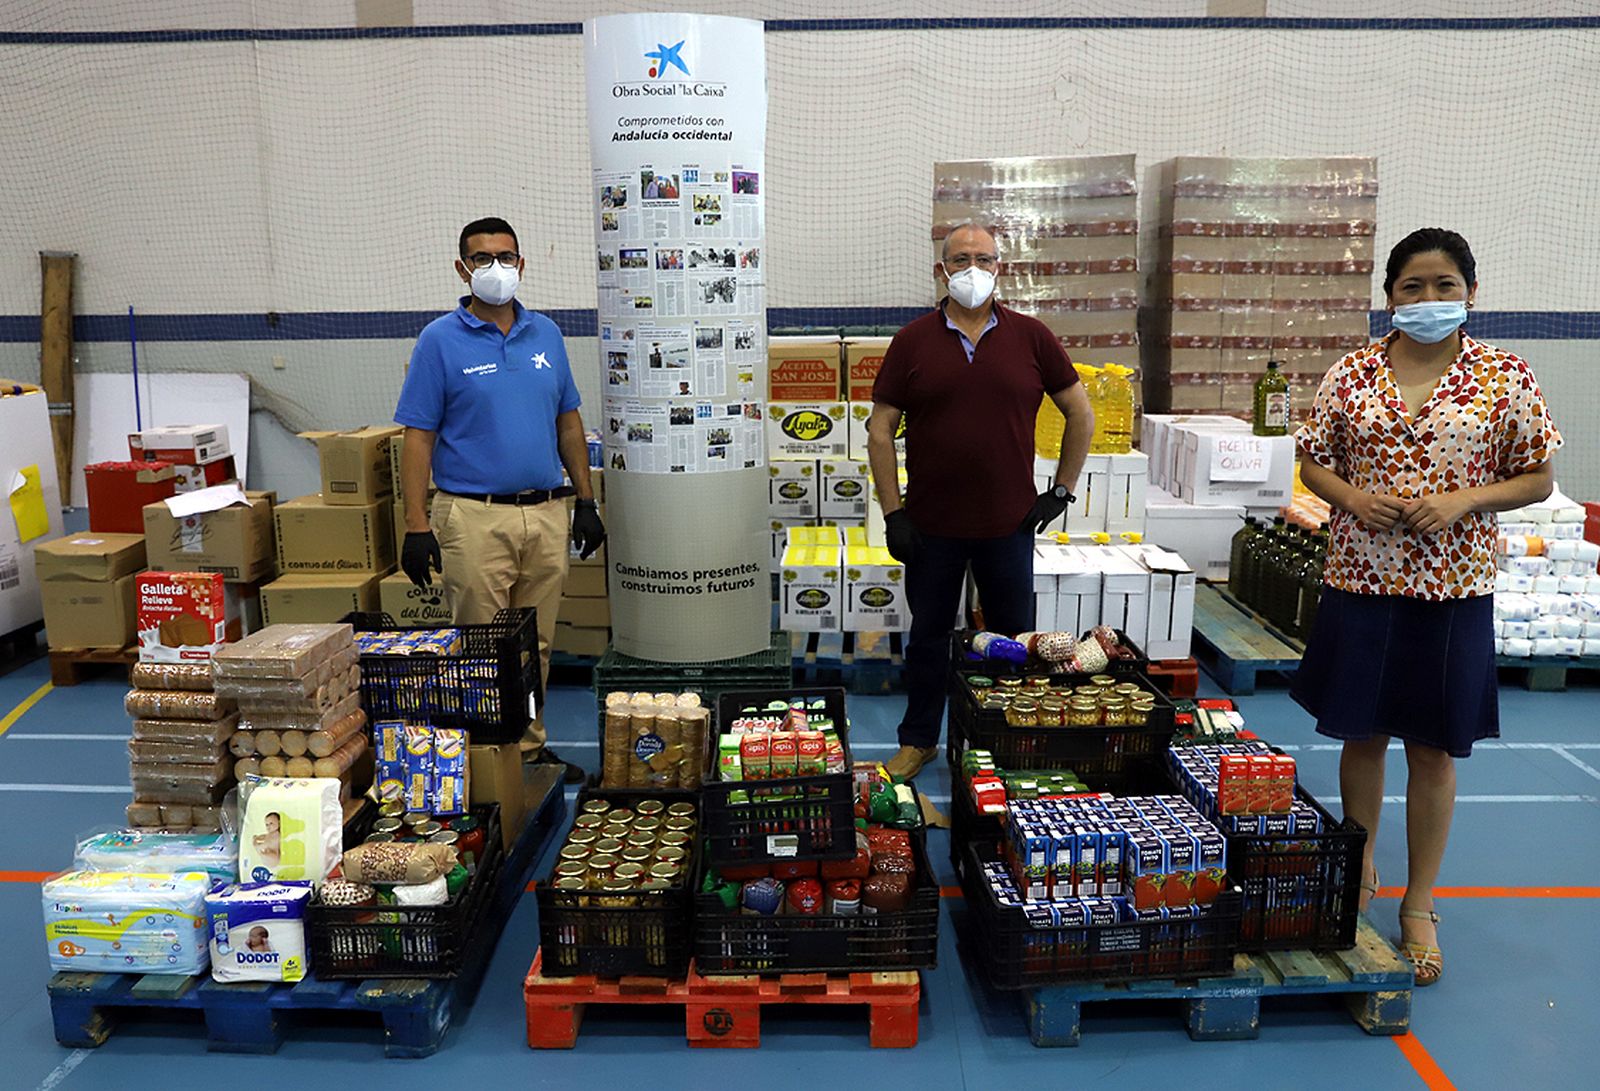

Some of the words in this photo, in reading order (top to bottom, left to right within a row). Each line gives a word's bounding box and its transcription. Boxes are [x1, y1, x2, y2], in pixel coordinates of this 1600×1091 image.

[612, 85, 640, 98] Obra
[642, 83, 676, 97] Social
[678, 83, 692, 96] "la
[693, 84, 727, 98] Caixa"
[617, 115, 703, 129] Comprometidos
[705, 117, 724, 127] con
[611, 129, 669, 142] Andalucía
[671, 129, 733, 142] occidental
[781, 362, 824, 370] ACEITES
[772, 371, 798, 381] SAN
[800, 371, 834, 381] JOSE
[851, 367, 877, 378] SAN
[783, 414, 829, 435] Ayala
[1218, 440, 1263, 453] ACEITE
[1220, 456, 1262, 470] OLIVA
[287, 561, 321, 569] CORTIJO
[321, 559, 336, 570] del
[615, 561, 689, 581] Cambiamos
[692, 561, 760, 583] presentes,
[141, 583, 184, 596] Galleta
[621, 577, 703, 596] construimos
[406, 587, 444, 600] CORTIJ
[141, 595, 174, 605] Relieve
[400, 606, 420, 619] del
[421, 604, 454, 620] Oliva
[748, 745, 765, 753] apis
[775, 743, 792, 751] apis
[802, 743, 819, 751] apis
[1062, 916, 1083, 924] TOMATE
[64, 945, 72, 954] 2
[236, 952, 280, 964] DODOT
